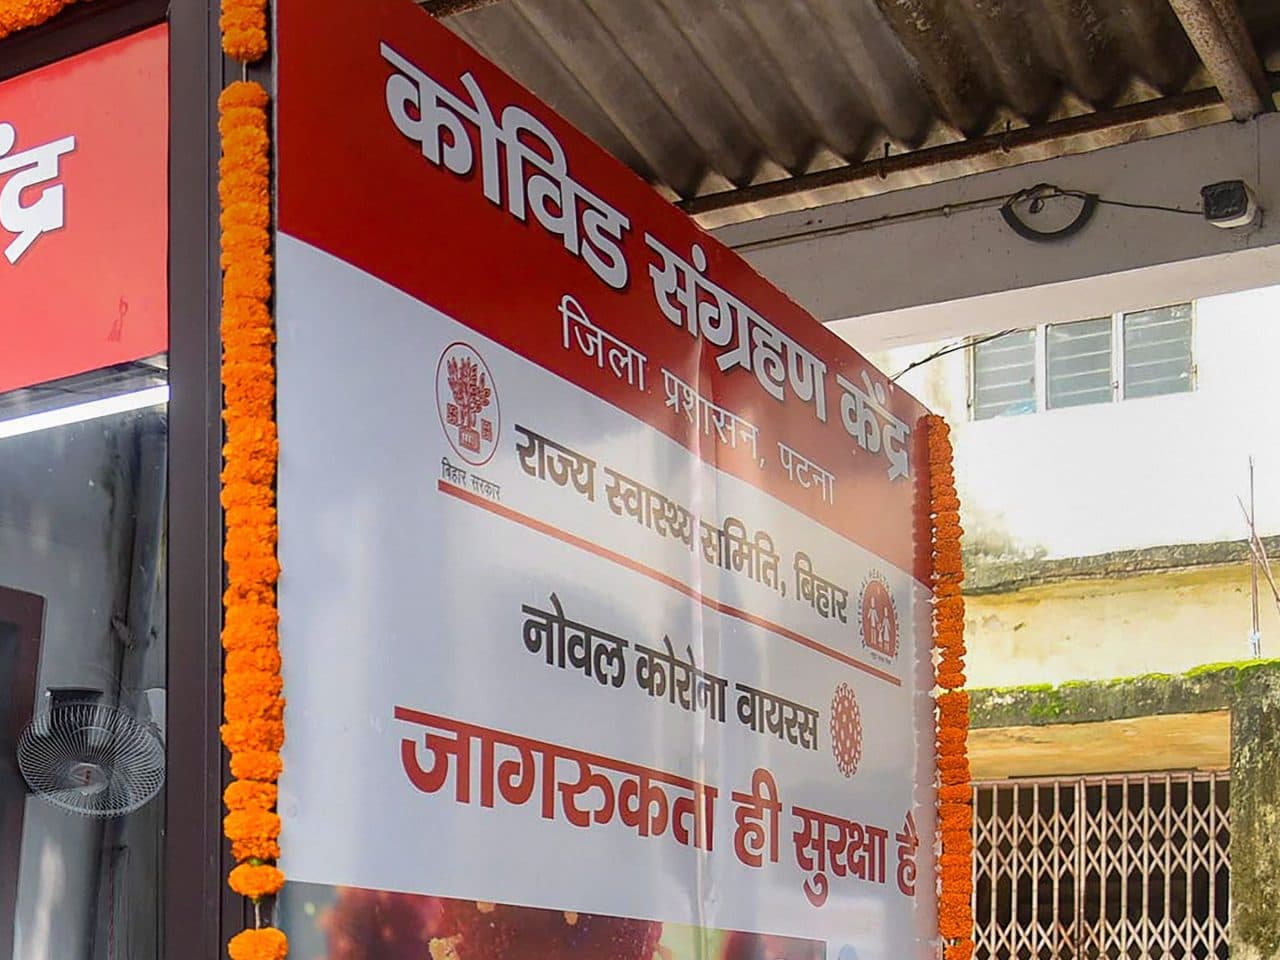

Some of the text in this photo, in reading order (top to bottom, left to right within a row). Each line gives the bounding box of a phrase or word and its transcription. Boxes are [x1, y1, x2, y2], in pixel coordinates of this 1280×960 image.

[379, 41, 910, 480] कोविड संग्रहण केंद्र
[441, 457, 501, 500] बिहार सरकार
[557, 295, 837, 504] जिला प्रशासन, पटना
[514, 423, 597, 502] राज्य
[604, 466, 695, 552] स्वास्थ्य
[698, 517, 787, 597] समिति,
[794, 552, 849, 624] बिहार
[521, 593, 819, 751] नोवल कोरोना वायरस
[731, 768, 782, 867] ही
[791, 805, 888, 907] सुरक्षा
[895, 810, 919, 896] है
